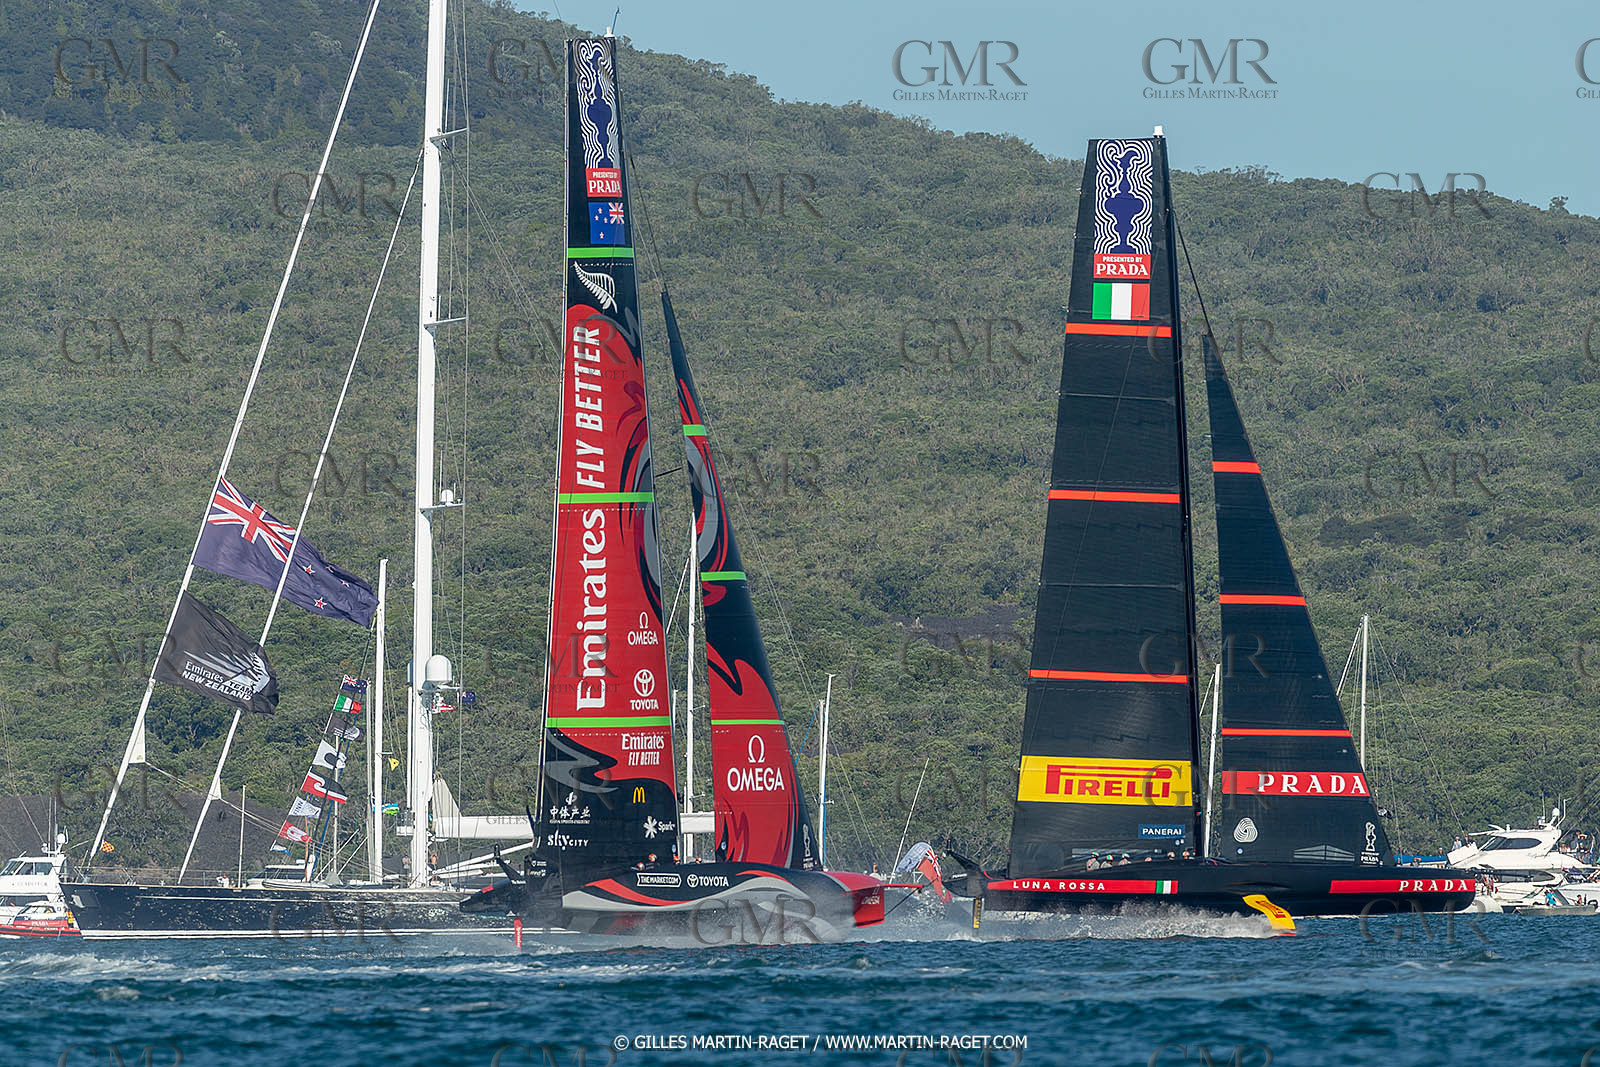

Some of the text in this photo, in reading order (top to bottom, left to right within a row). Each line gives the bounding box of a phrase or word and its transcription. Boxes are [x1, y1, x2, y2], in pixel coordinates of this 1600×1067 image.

[589, 180, 621, 193] PRADA
[1096, 264, 1148, 276] PRADA
[573, 326, 605, 489] FLY BETTER
[576, 508, 607, 711] Emirates
[627, 631, 658, 646] OMEGA
[185, 661, 224, 683] Emirates
[182, 670, 252, 700] NEW ZEALAND
[630, 699, 659, 710] TOYOTA
[622, 732, 664, 750] Emirates
[628, 752, 660, 766] FLY BETTER
[727, 767, 784, 792] OMEGA
[1045, 764, 1173, 798] PIRELLI
[1257, 774, 1366, 794] PRADA
[658, 822, 674, 832] Spark
[1142, 828, 1182, 836] PANERAI
[699, 876, 729, 886] TOYOTA
[1013, 881, 1105, 890] LUNA ROSSA
[1399, 880, 1468, 892] PRADA
